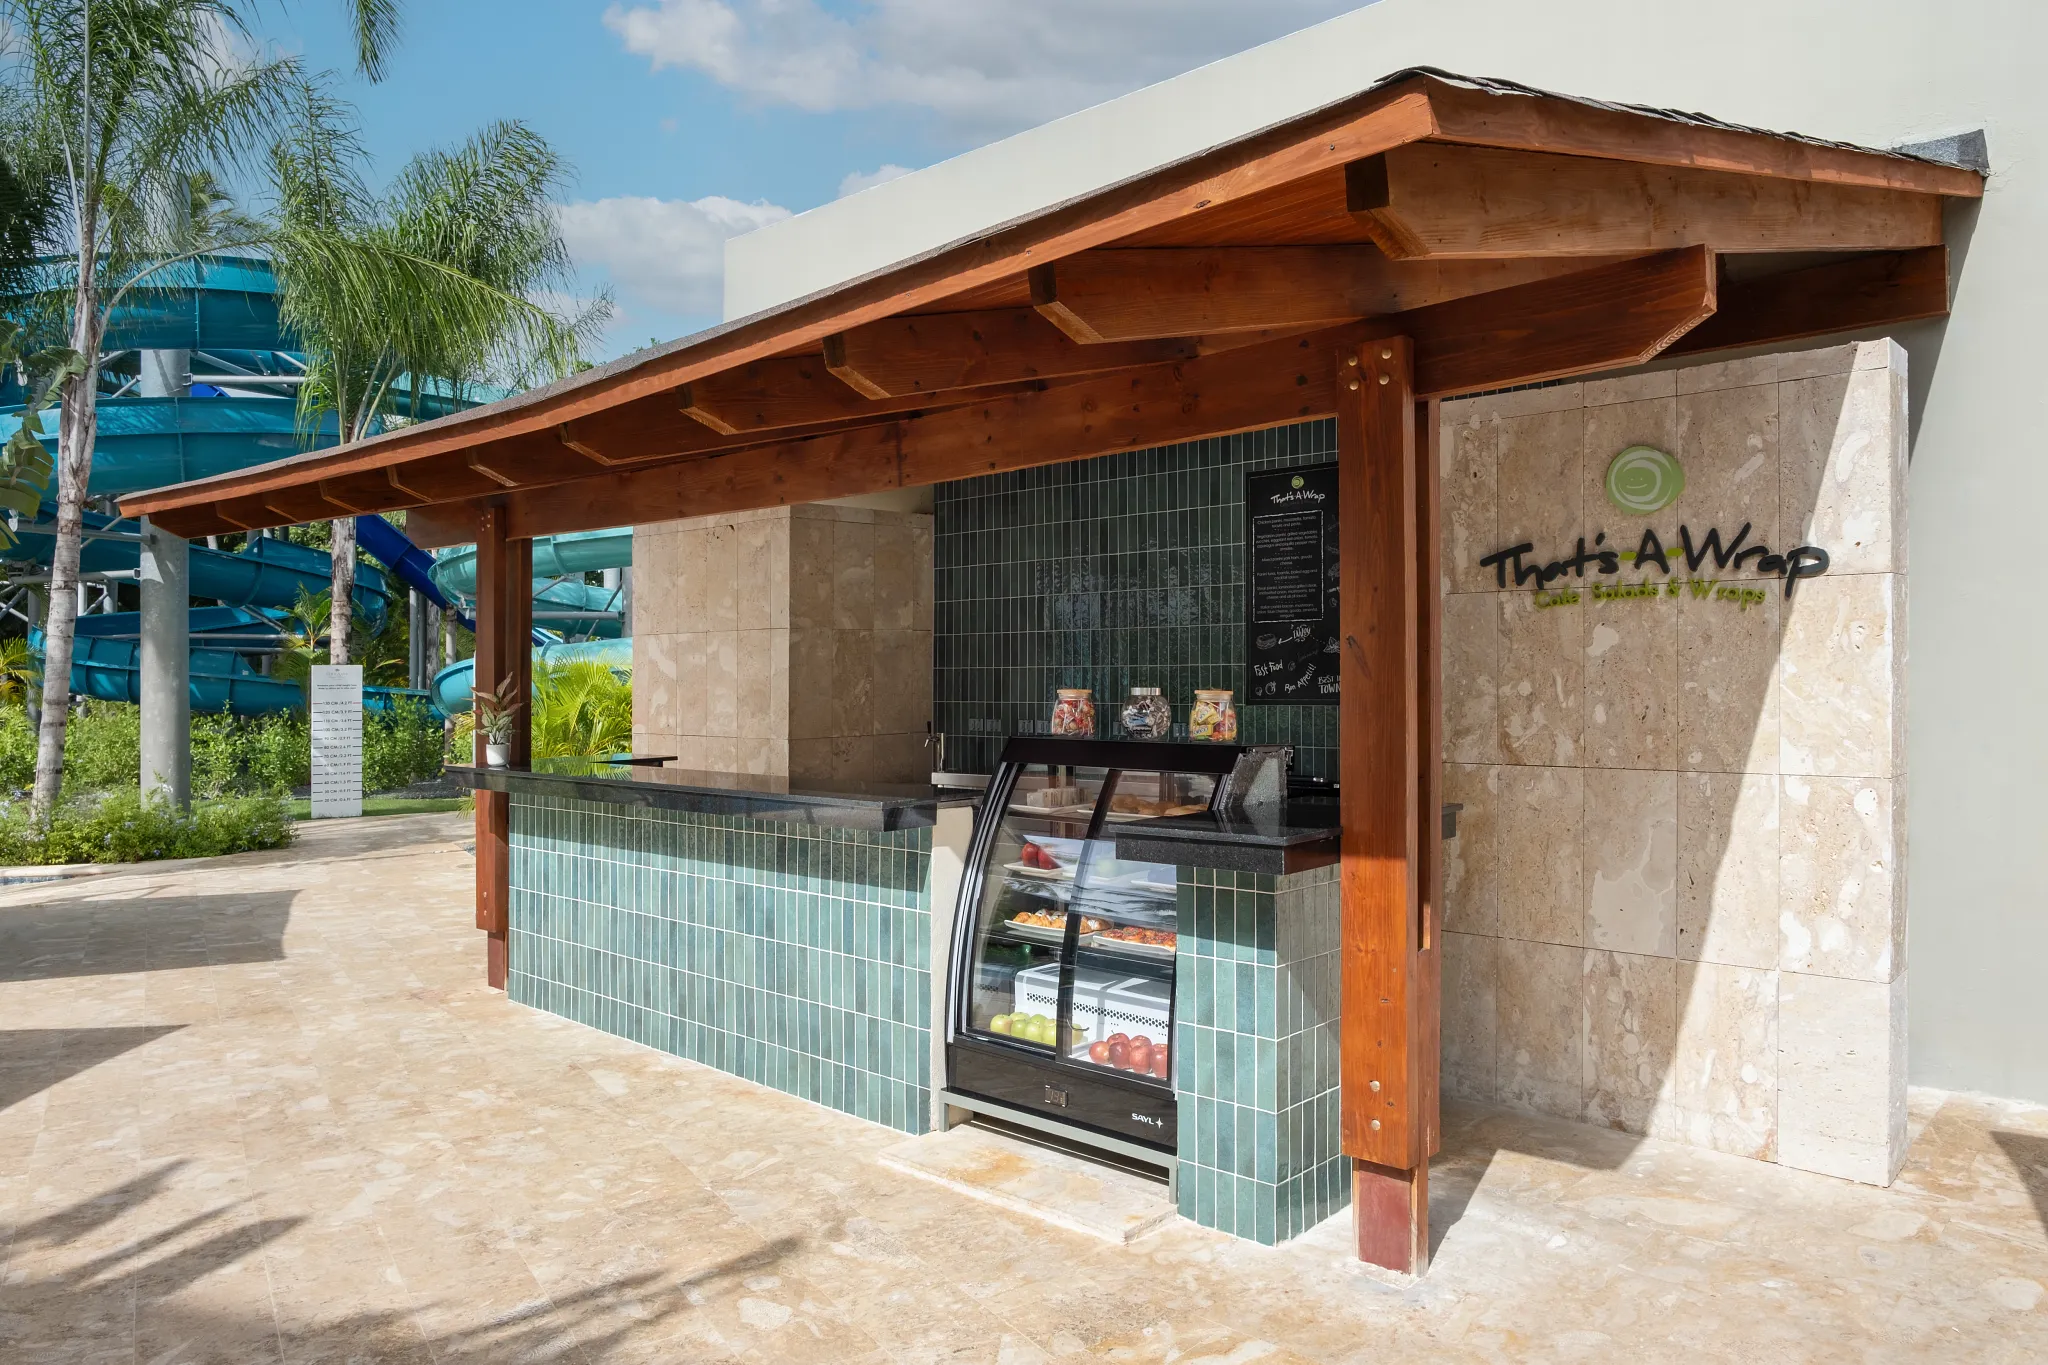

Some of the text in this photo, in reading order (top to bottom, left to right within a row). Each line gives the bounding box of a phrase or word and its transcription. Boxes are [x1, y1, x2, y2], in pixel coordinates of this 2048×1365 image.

[1591, 577, 1659, 601] Salads
[1666, 576, 1681, 598] &
[1688, 578, 1767, 612] Wraps
[1253, 659, 1284, 677] Fast Food
[1131, 1113, 1155, 1125] SAYL
